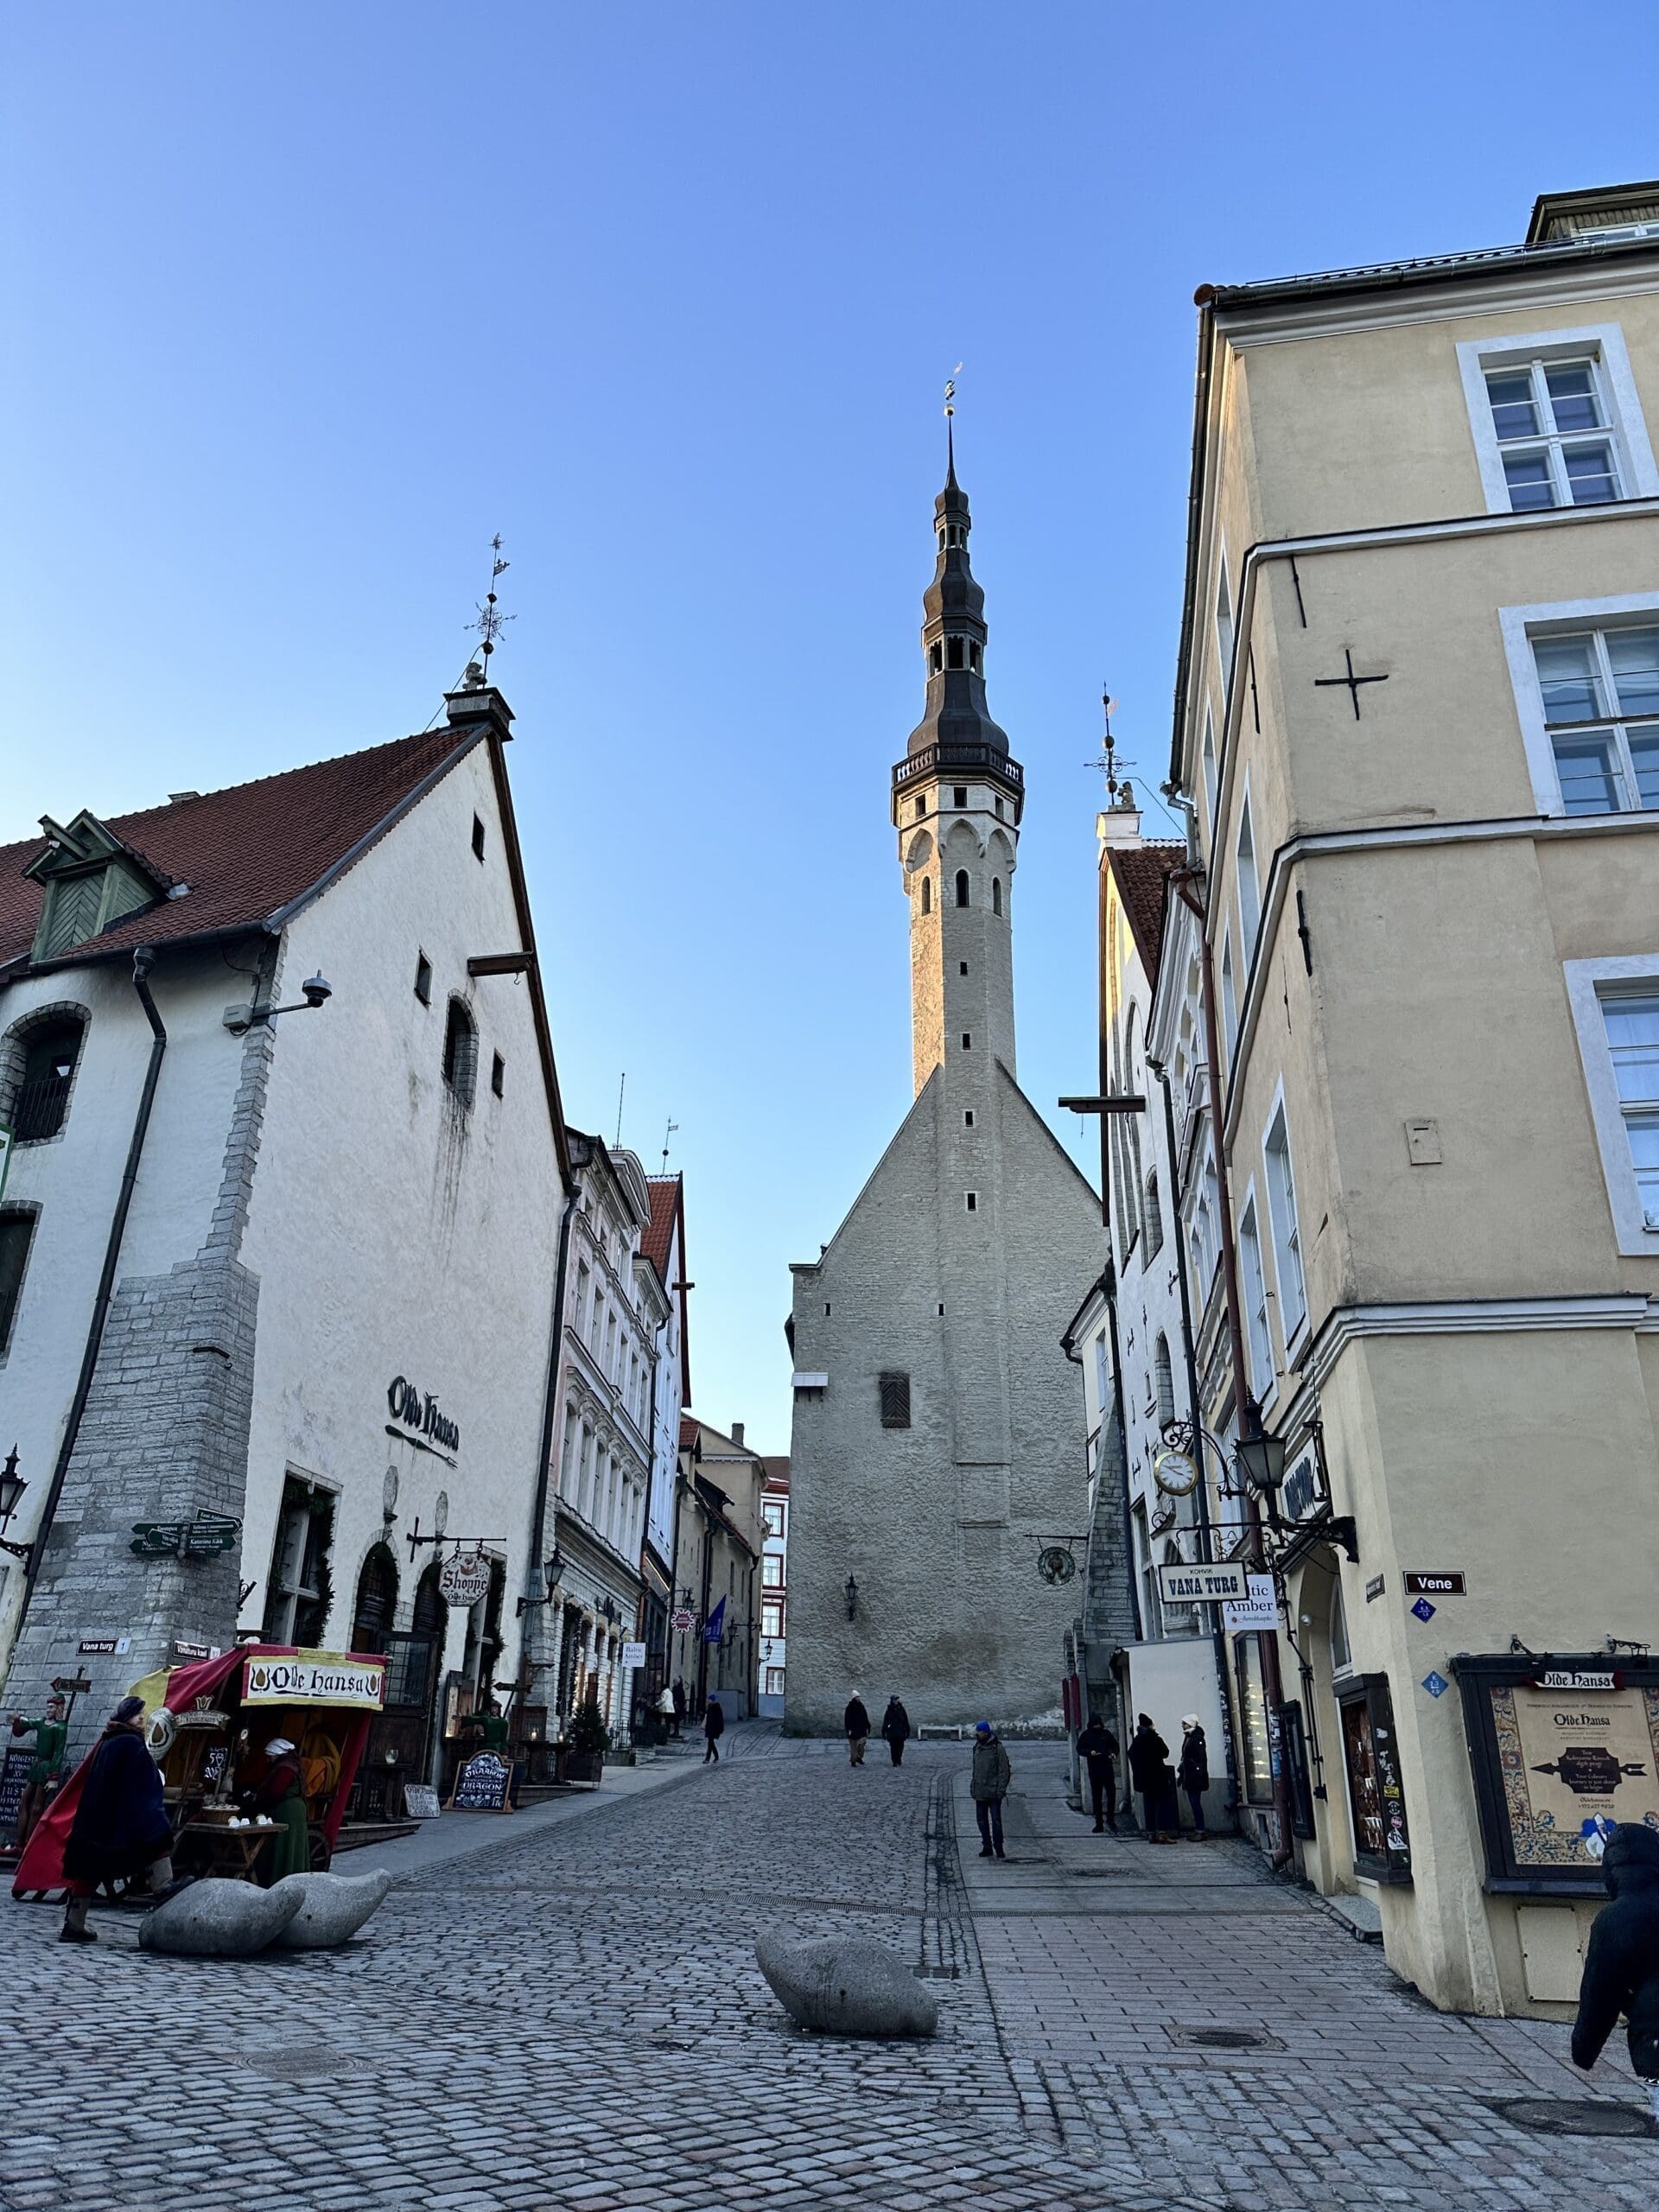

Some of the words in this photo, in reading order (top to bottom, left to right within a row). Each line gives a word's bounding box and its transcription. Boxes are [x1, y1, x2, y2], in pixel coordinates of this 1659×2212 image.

[442, 1569, 488, 1594] Shoppe
[1167, 1577, 1204, 1596] VANA
[1205, 1575, 1239, 1594] TURG
[1417, 1577, 1453, 1590] Vene
[1250, 1584, 1269, 1597] tic
[1226, 1600, 1274, 1612] Amber
[82, 1642, 99, 1650] Vana
[99, 1641, 114, 1651] turg
[120, 1642, 125, 1650] 1
[271, 1665, 305, 1689] Olde
[1554, 1713, 1580, 1726] Olde
[462, 1782, 503, 1791] DRAGON
